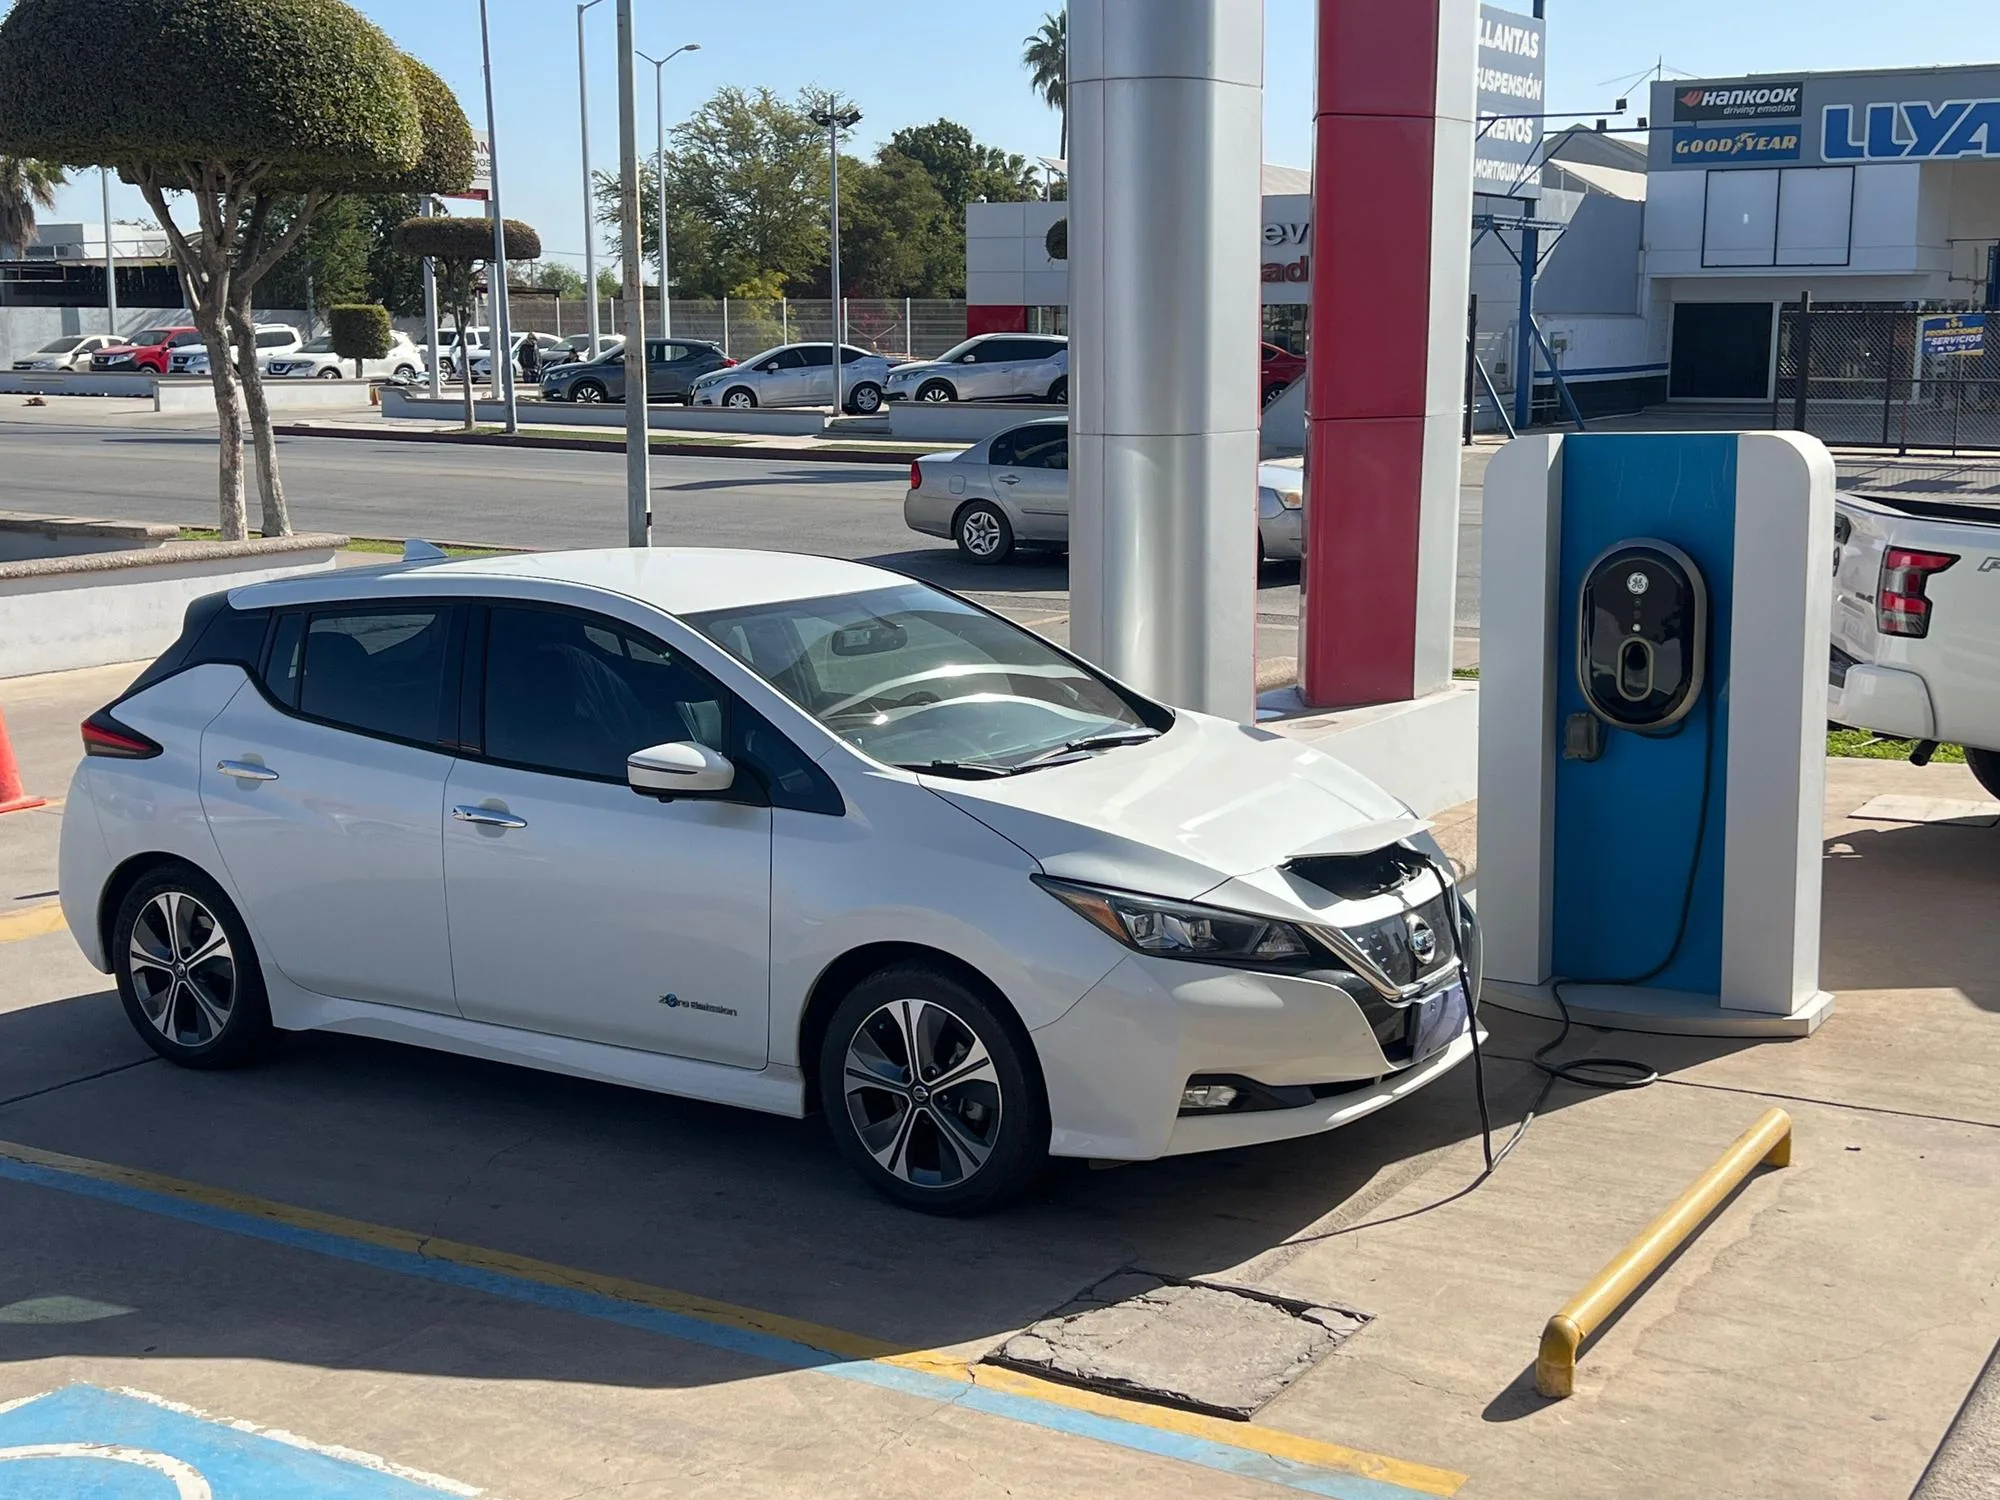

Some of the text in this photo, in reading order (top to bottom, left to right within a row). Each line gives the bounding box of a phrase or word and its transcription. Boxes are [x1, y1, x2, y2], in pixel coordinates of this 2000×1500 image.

[1723, 104, 1796, 116] driving emotion
[1478, 110, 1534, 144] FRENOS
[1475, 157, 1541, 185] MORTIGUADORES
[1930, 334, 1983, 346] SERVICIOS
